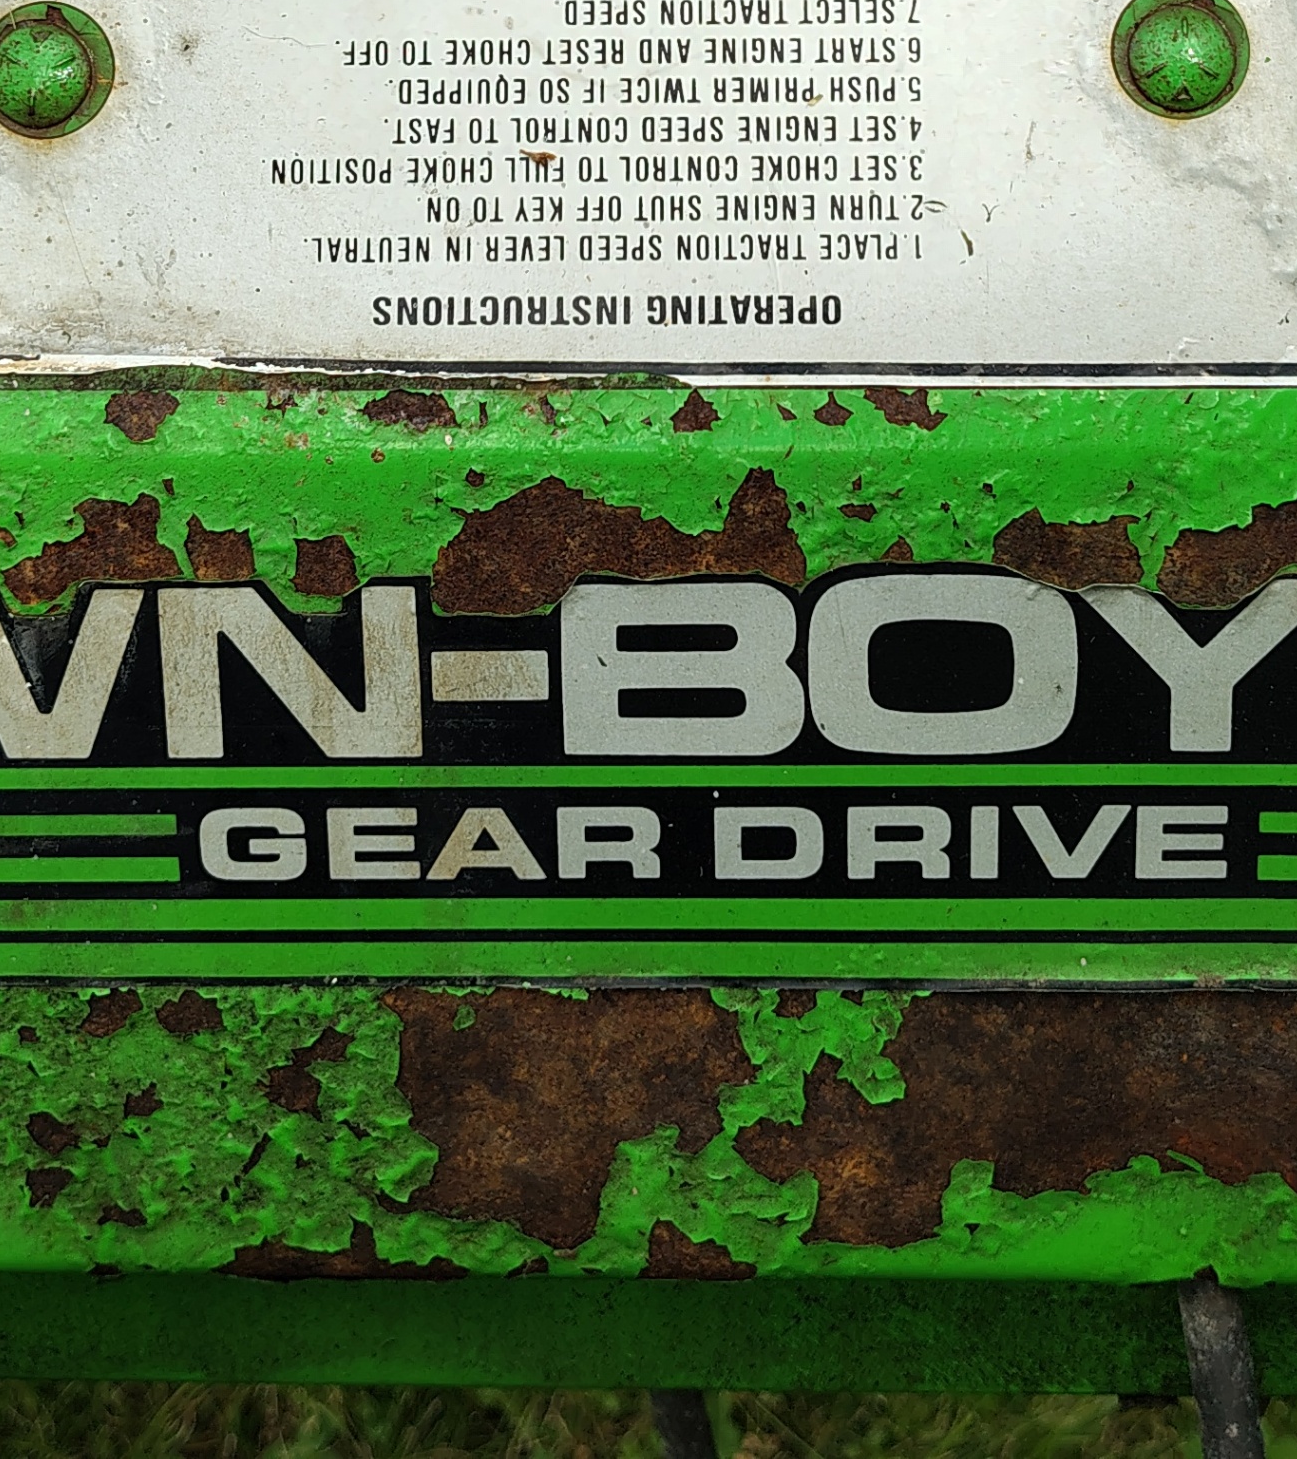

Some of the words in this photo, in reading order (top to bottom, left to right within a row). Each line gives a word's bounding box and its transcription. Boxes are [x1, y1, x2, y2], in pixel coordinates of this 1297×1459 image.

[402, 40, 433, 67] TO
[445, 39, 531, 66] CHOKE
[542, 38, 624, 66] RESET
[639, 38, 691, 65] AND
[704, 37, 802, 65] ENGINE
[539, 77, 570, 104] SO
[582, 78, 605, 104] IF
[619, 77, 701, 104] TWICE
[713, 76, 814, 103] PRIMER
[469, 117, 499, 144] TO
[510, 116, 628, 144] CONTROL
[641, 116, 724, 143] SPEED
[737, 115, 837, 143] ENGINE
[406, 156, 493, 184] CHOKE
[504, 149, 564, 183] FULL
[578, 156, 609, 183] TO
[619, 155, 738, 183] CONTROL
[751, 155, 838, 182] CHOKE
[473, 196, 504, 223] TO
[515, 196, 563, 223] KEY
[576, 195, 622, 222] OFF
[634, 194, 702, 222] SHUT
[715, 194, 815, 221] ENGINE
[446, 236, 472, 262] IN
[485, 235, 565, 262] LEVER
[579, 234, 662, 261] SPEED
[677, 234, 807, 261] TRACTION
[372, 295, 631, 326] INSTRUCTIONS
[647, 294, 842, 325] OPERATING
[198, 805, 661, 882] GEAR
[713, 804, 1229, 879] DRIVE
